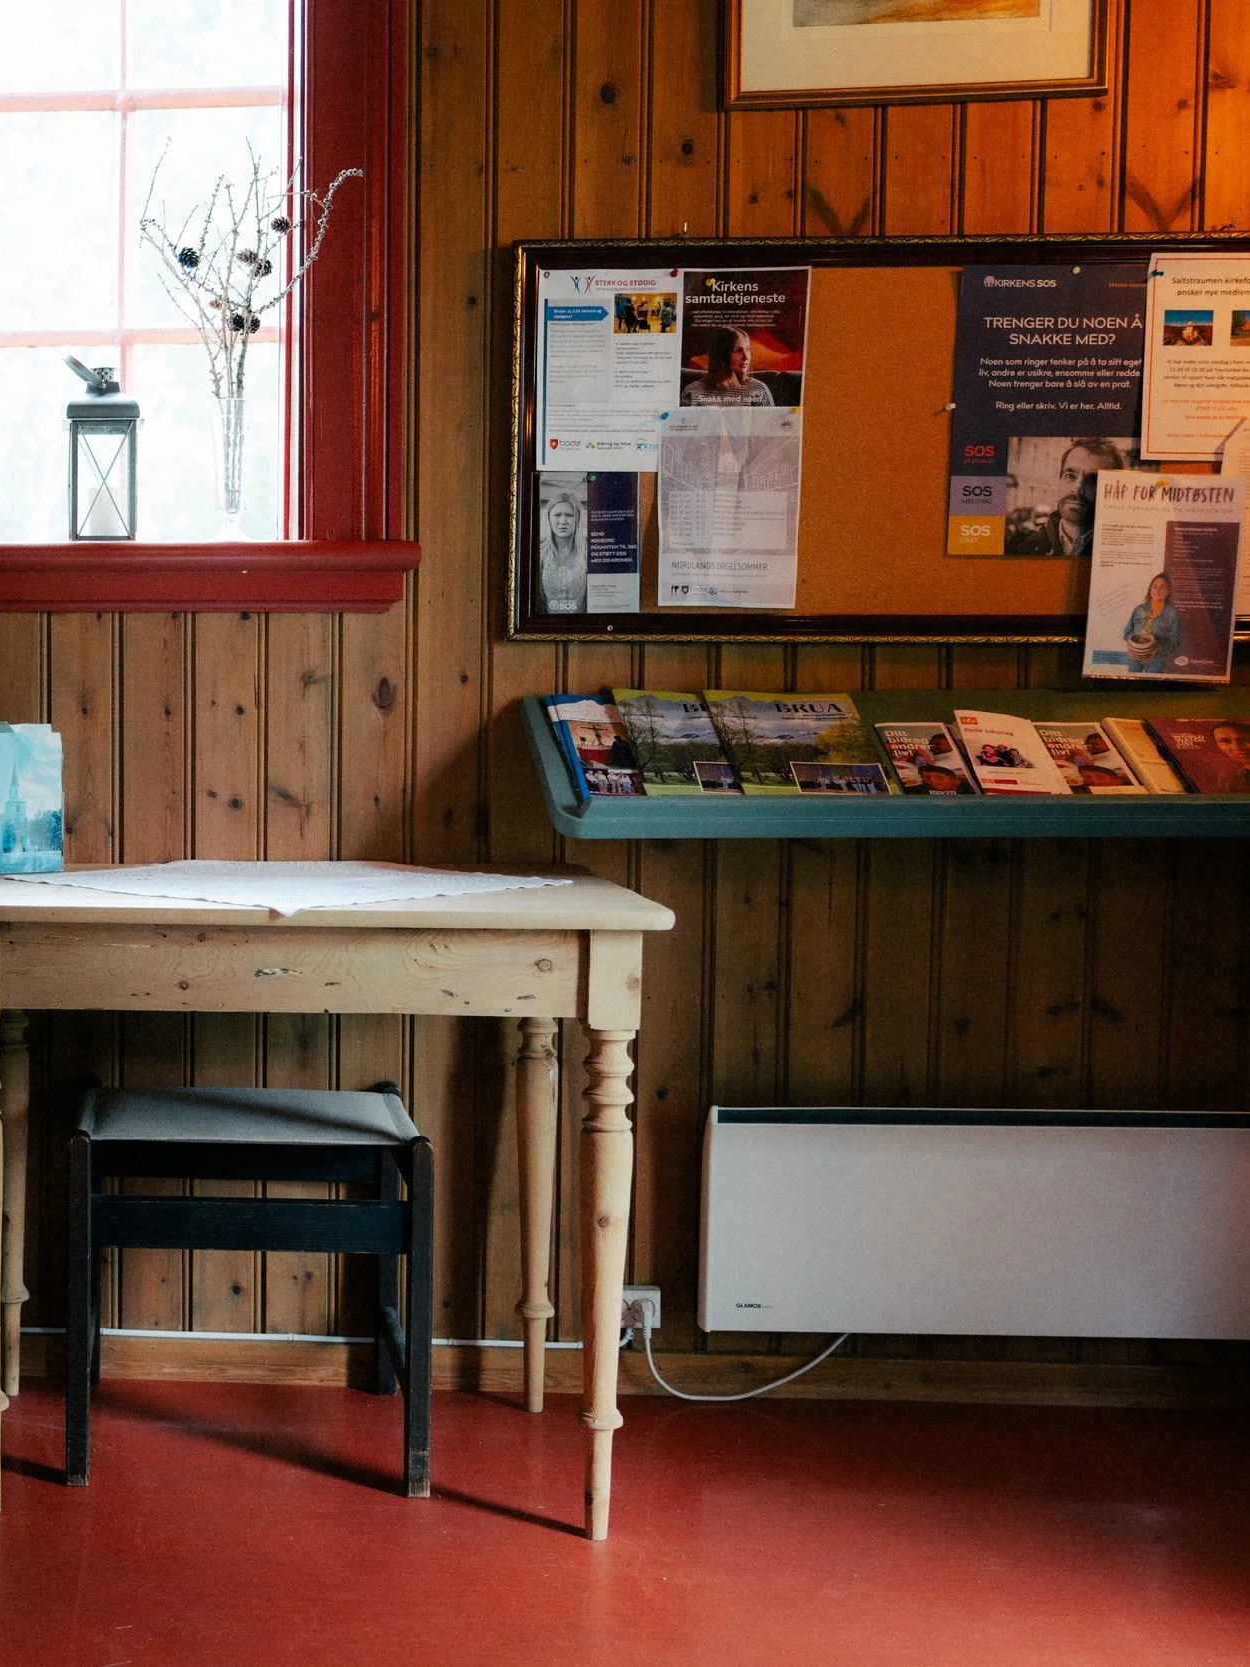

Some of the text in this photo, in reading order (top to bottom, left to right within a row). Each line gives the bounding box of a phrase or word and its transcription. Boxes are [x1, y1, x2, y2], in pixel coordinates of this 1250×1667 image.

[712, 281, 759, 291] Kirkens
[995, 279, 1057, 288] KIRKENS SOS
[685, 293, 786, 305] samtaletjeneste
[983, 313, 1143, 328] TRENGER DU NOEN Å
[1009, 333, 1116, 345] SNAKKE MED?
[980, 357, 1003, 365] Noen
[1024, 357, 1048, 367] ringer
[1077, 357, 1089, 367] på
[1090, 357, 1096, 365] å
[1123, 358, 1142, 368] eget
[978, 368, 990, 377] liv,
[991, 368, 1016, 376] andre
[1027, 369, 1053, 377] usikre,
[1013, 380, 1043, 389] trenger
[1066, 379, 1072, 387] å
[1073, 379, 1086, 387] slå
[1112, 381, 1131, 390] prat.
[995, 401, 1015, 411] Ring
[1097, 402, 1122, 410] Alltid.
[964, 445, 995, 457] SOS
[962, 485, 992, 497] SOS
[1104, 480, 1235, 503] HÅP FOR MIDTØSTEN
[960, 525, 991, 536] SOS
[671, 561, 768, 571] NORDLANDS ORGELSOMMER
[774, 703, 842, 713] BRUA
